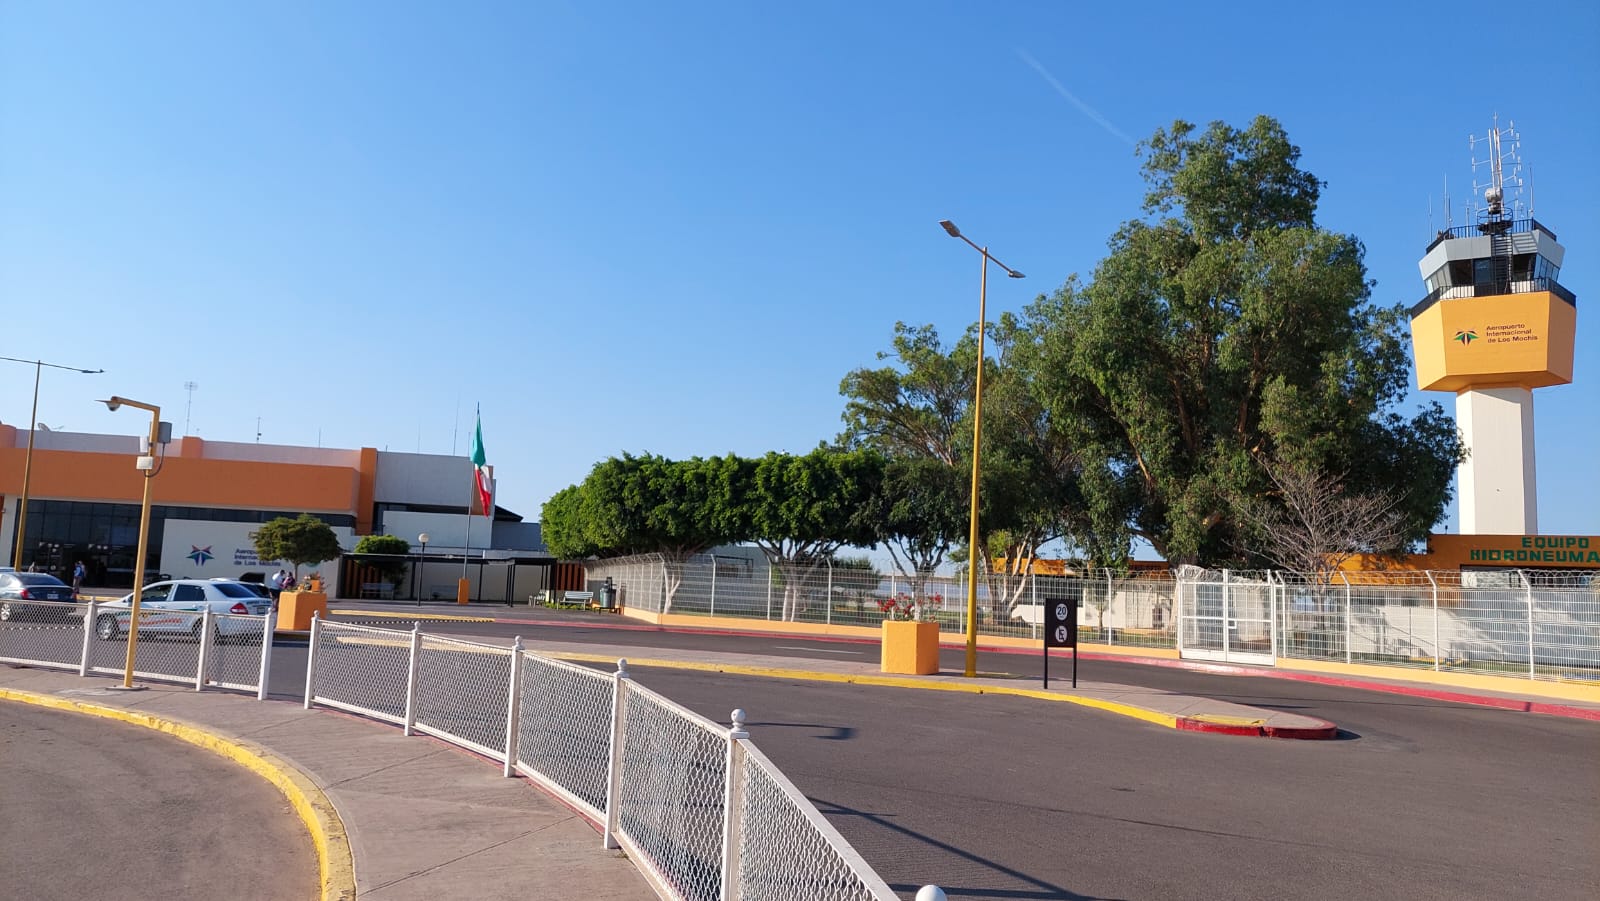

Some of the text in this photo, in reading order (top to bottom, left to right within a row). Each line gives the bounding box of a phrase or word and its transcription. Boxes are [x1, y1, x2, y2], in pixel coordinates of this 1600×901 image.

[1522, 537, 1589, 549] EQUIPO
[1470, 550, 1600, 563] HIDRONEUMA
[1057, 606, 1067, 615] 20
